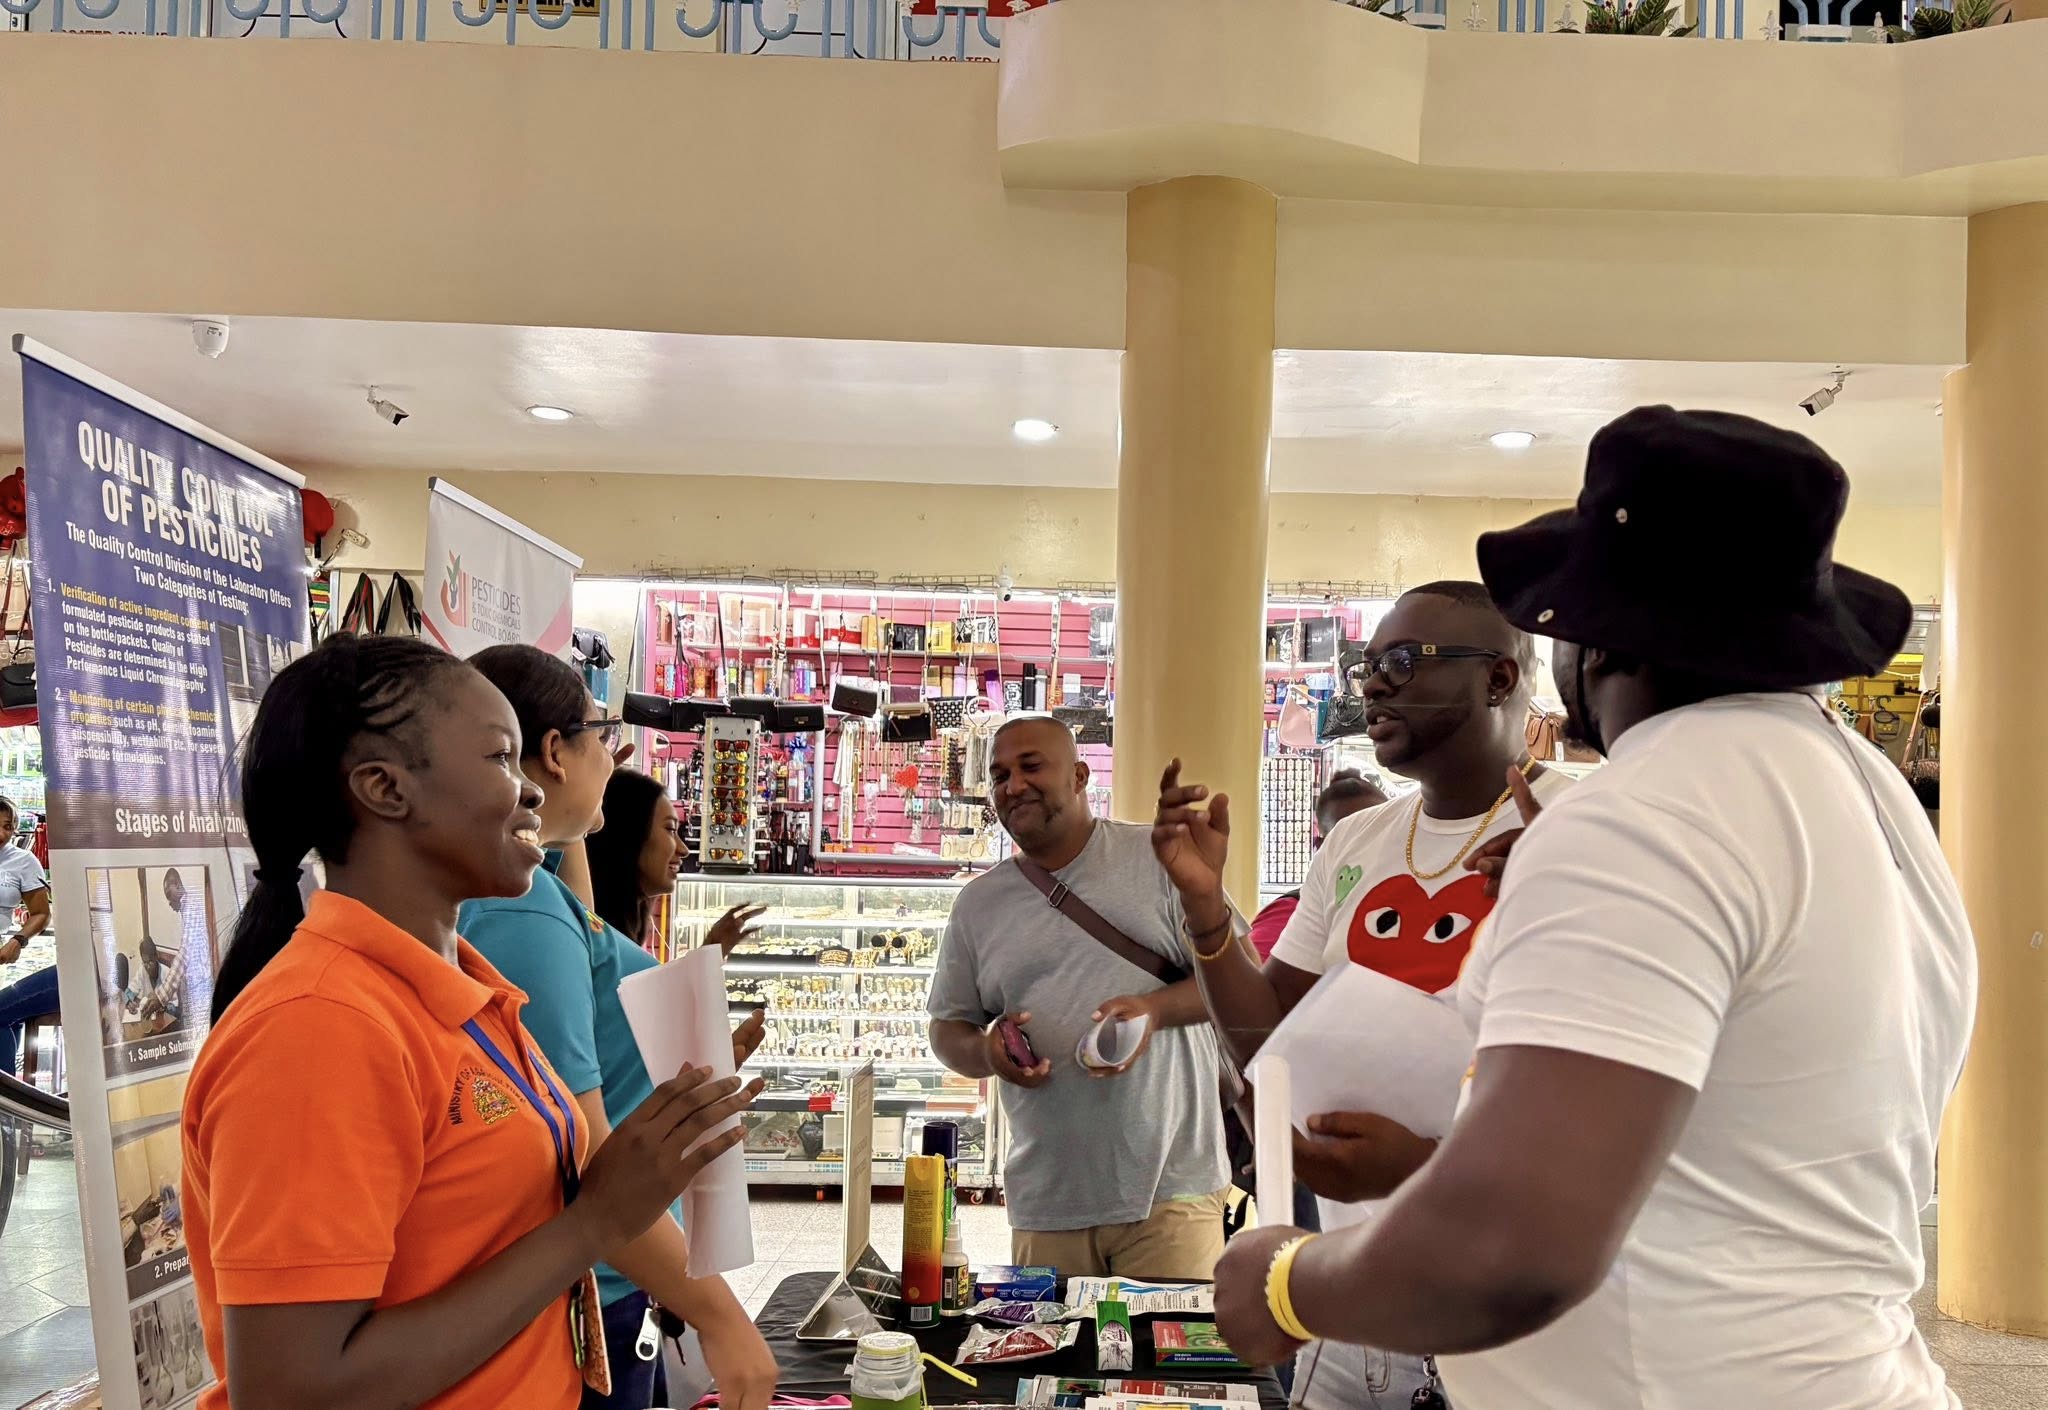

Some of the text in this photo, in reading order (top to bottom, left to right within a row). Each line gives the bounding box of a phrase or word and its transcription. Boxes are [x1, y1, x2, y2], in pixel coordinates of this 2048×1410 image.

[78, 421, 273, 537] QUALITY CONTROL
[102, 479, 262, 572] OF PESTICIDES
[66, 521, 291, 608] The Quality Control Division of the Laboratory Offers
[47, 578, 56, 593] 1.
[61, 582, 107, 606] Verification
[109, 597, 117, 609] of
[120, 600, 143, 615] active
[145, 604, 179, 624] ingredient
[209, 621, 216, 633] of
[134, 565, 249, 616] Two Categories of Testing:
[472, 576, 521, 615] PESTICIDES
[62, 601, 210, 646] formulated pesticide products as stated
[64, 621, 184, 657] on the bottle/packets. Quality of
[472, 617, 497, 640] CONTROL
[65, 637, 208, 678] Pesticides are determined by the High
[67, 655, 118, 677] Performance
[120, 665, 144, 682] Liquid
[55, 687, 64, 701] 2.
[115, 698, 123, 710] of
[126, 700, 154, 714] certain
[113, 715, 133, 728] such
[135, 719, 145, 730] as
[147, 718, 161, 733] pH,
[74, 746, 110, 760] pesticide
[115, 808, 168, 838] Stages
[172, 810, 186, 833] of
[128, 1050, 137, 1063] 1.
[138, 1044, 167, 1061] Sample
[448, 1077, 465, 1125] MINISTRY
[154, 1255, 191, 1279] 2. Prepar
